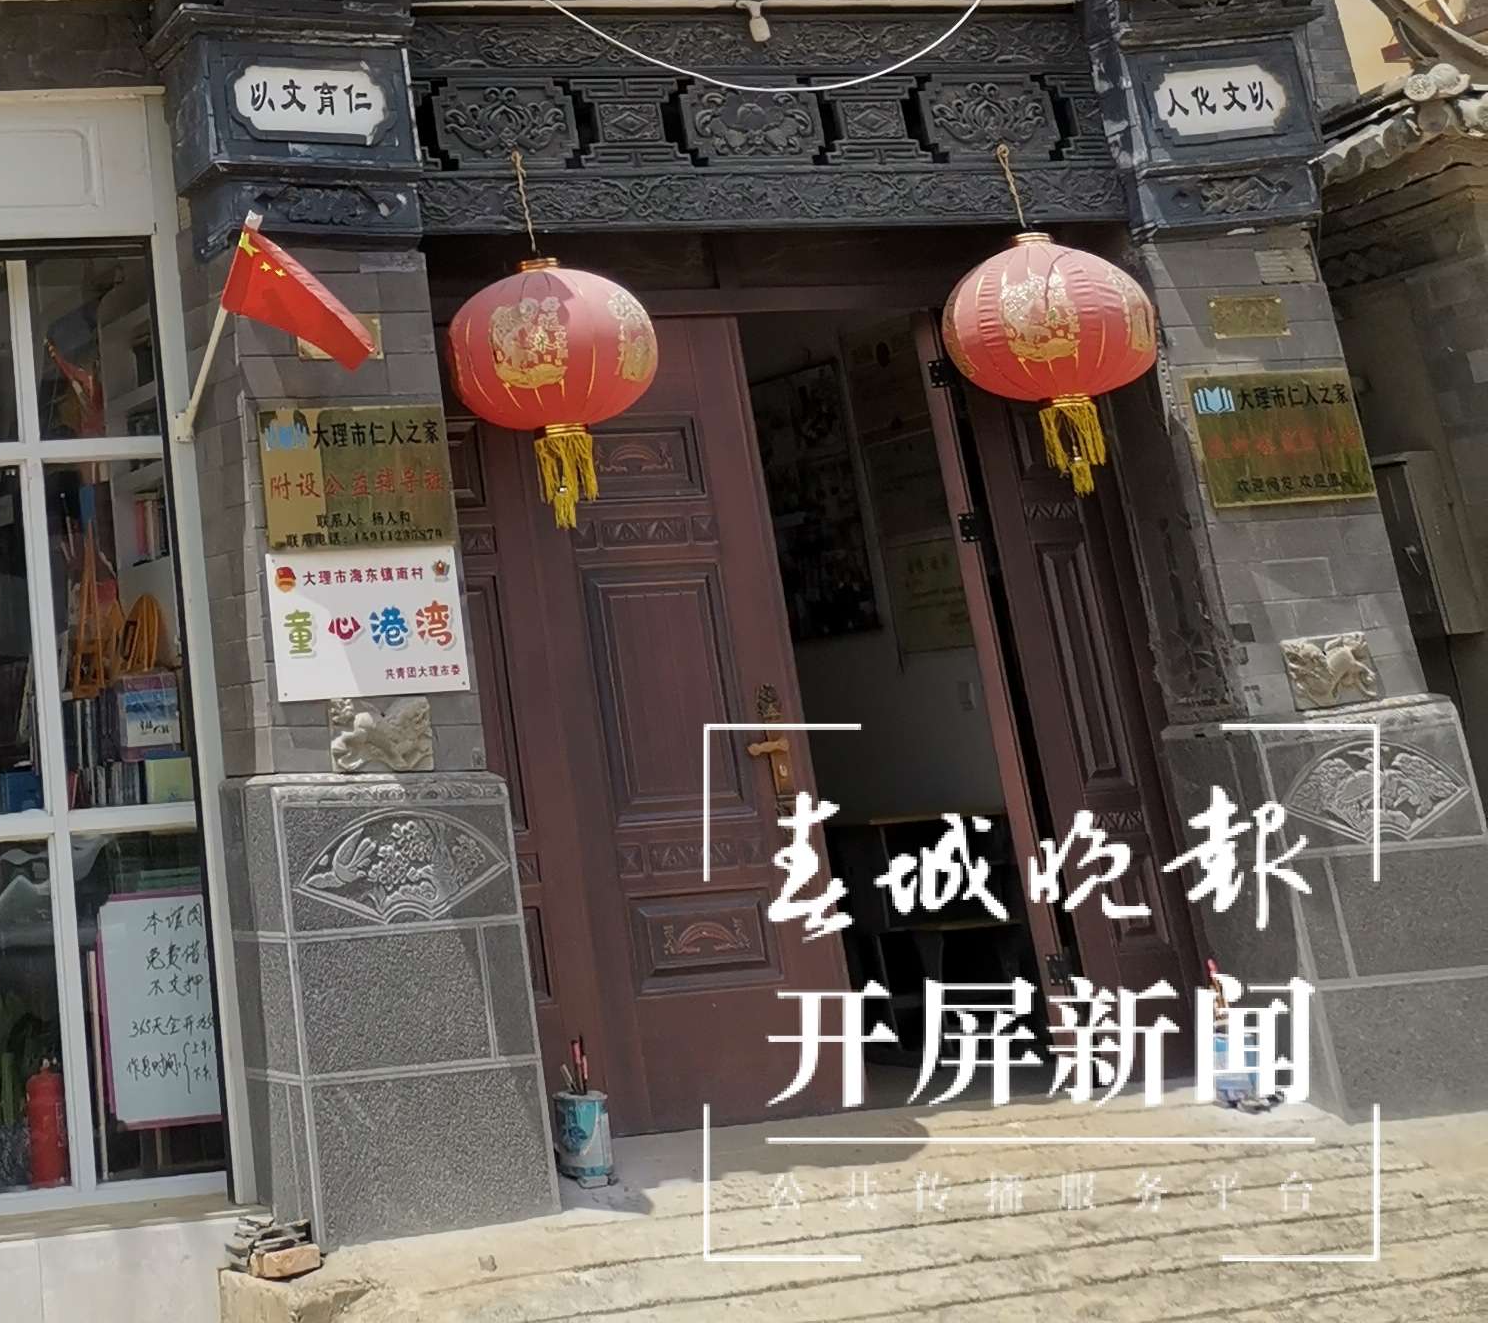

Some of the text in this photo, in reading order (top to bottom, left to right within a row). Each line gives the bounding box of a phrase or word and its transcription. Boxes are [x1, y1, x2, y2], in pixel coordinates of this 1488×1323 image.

[1237, 383, 1350, 411] 大理市仁人之家
[312, 419, 441, 449] 大理市仁人之家
[302, 566, 424, 587] 大理市海东镇南村
[282, 599, 454, 656] 童心港湾
[385, 663, 461, 681] 共青团大理市委
